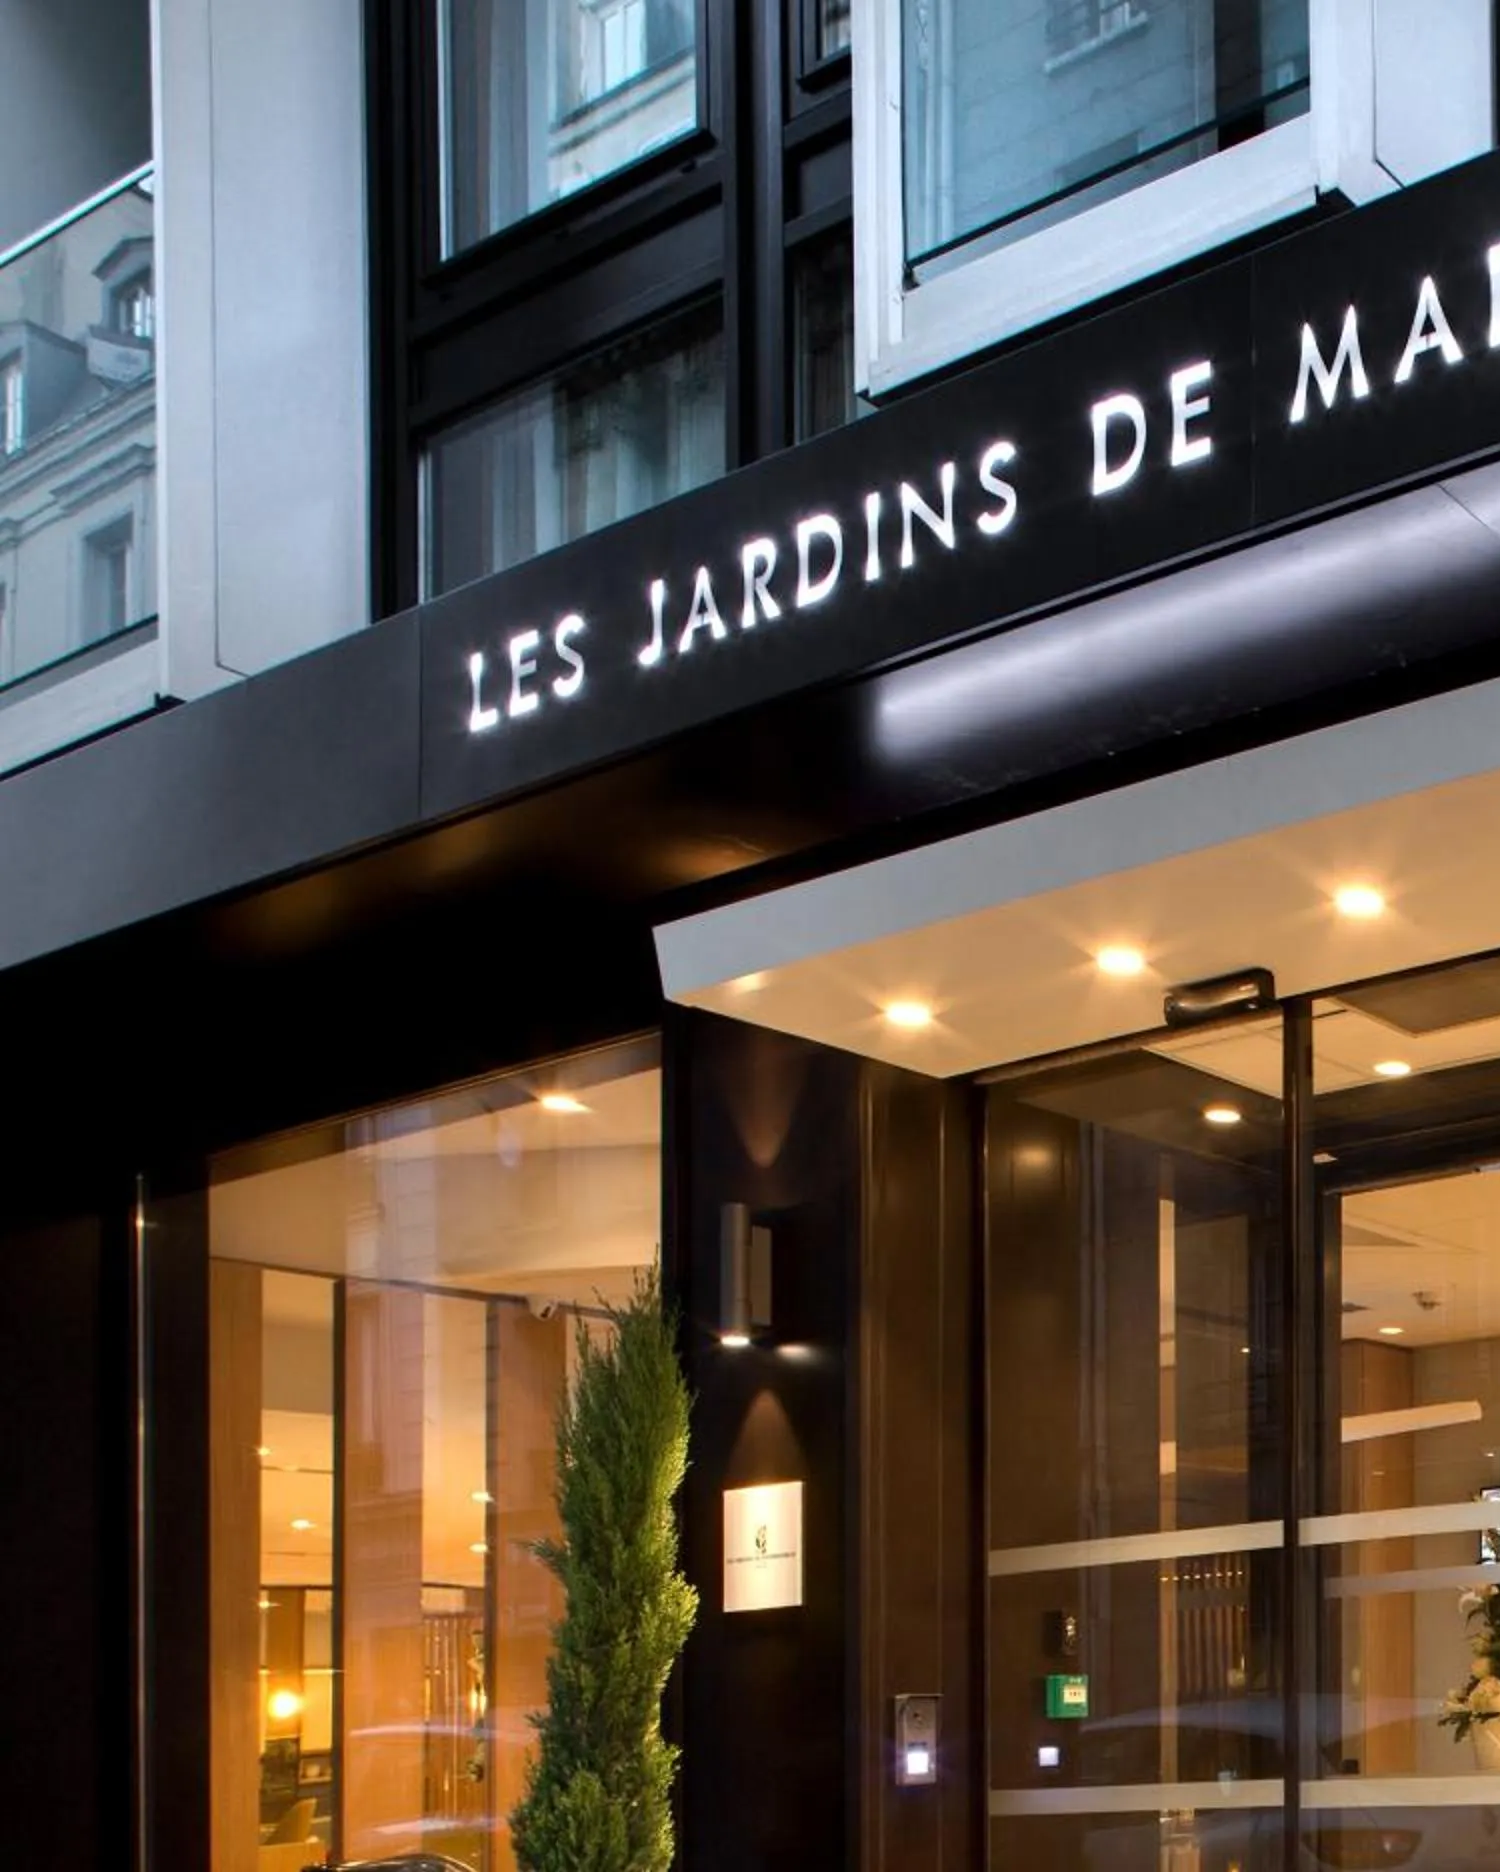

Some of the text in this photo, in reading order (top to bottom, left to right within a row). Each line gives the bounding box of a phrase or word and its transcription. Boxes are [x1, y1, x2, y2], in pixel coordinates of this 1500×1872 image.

[467, 613, 586, 734] LES
[637, 440, 1017, 668] JARDINS
[1090, 360, 1213, 497] DE
